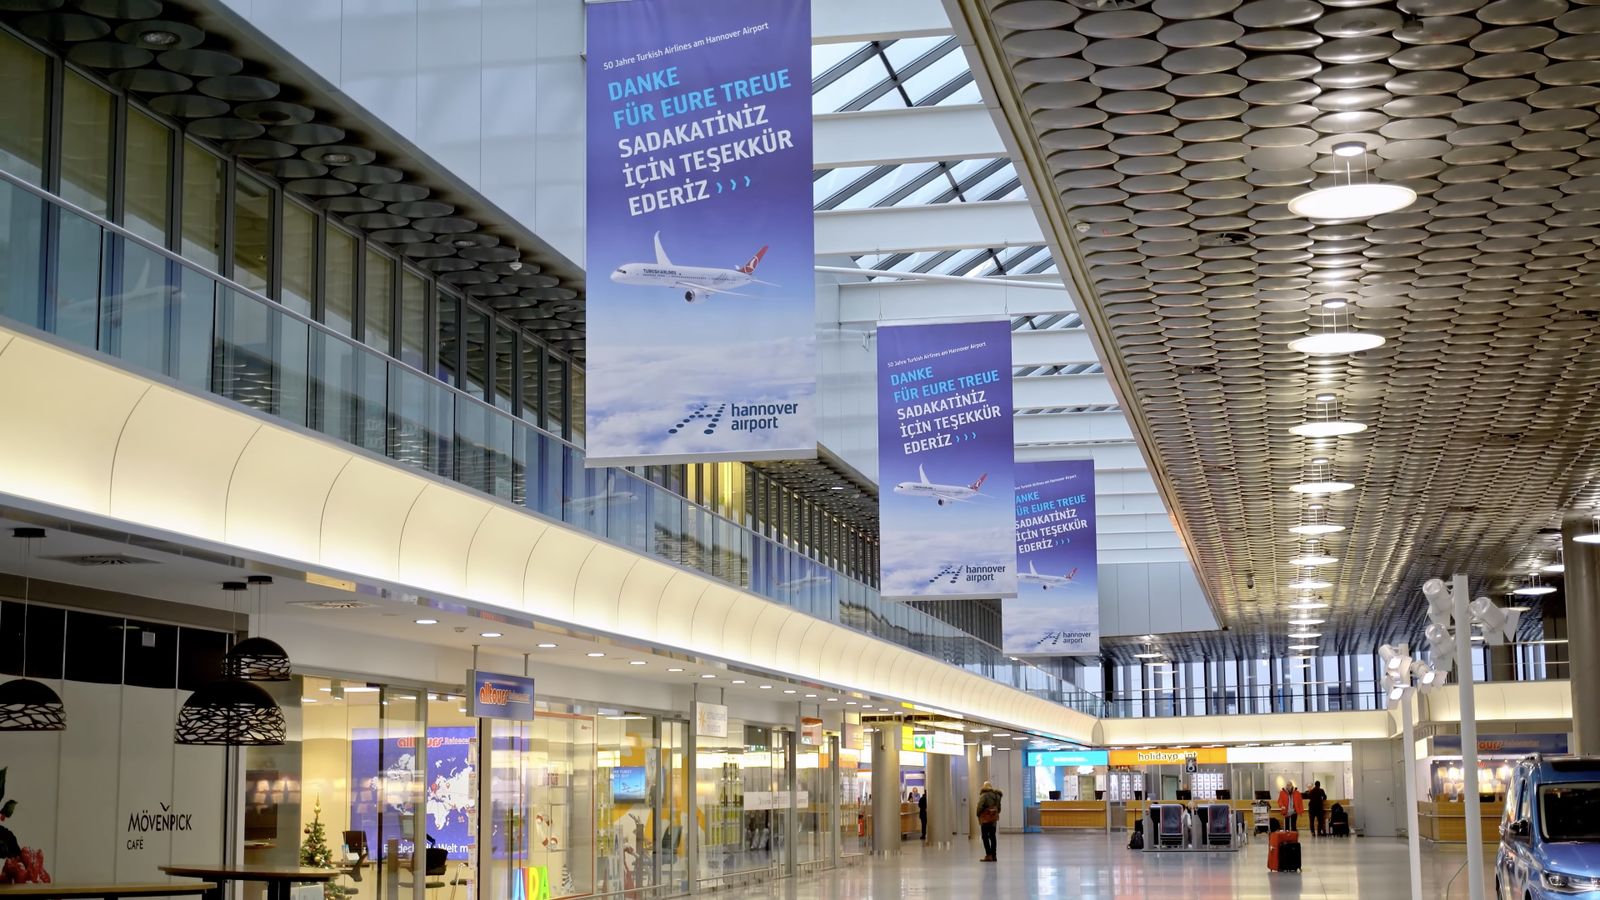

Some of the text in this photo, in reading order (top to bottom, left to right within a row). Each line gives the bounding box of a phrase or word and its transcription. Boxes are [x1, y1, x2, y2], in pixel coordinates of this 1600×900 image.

[603, 21, 769, 71] 50 Jahre Turkish Airlines am Hannover Airport
[608, 66, 680, 101] DANKE
[613, 68, 792, 130] FÜR EURE TREUE
[618, 103, 768, 158] SADAKATİNİZ
[622, 128, 794, 189] İÇİN TEŞEKKÜR
[628, 178, 710, 217] EDERİZ
[907, 354, 924, 364] Turkish
[923, 351, 941, 361] Airlines
[948, 345, 970, 354] Hannover
[970, 341, 986, 350] Airport
[890, 366, 934, 386] DANKE
[893, 369, 1000, 403] FÜR EURE TREUE
[731, 402, 798, 417] hannover
[897, 389, 987, 420] SADAKATİNİZ
[731, 415, 778, 432] airport
[900, 404, 1002, 439] İÇİN TEŞEKKÜR
[904, 432, 952, 455] EDERİZ
[1016, 491, 1039, 504] ANKE
[1016, 494, 1087, 516] ÜR EURE TREUE
[1015, 507, 1077, 529] SADAKATİNİZ
[1016, 518, 1088, 542] İÇİN TEŞEKKÜR
[1018, 537, 1053, 554] EDERİZ
[965, 564, 1006, 574] hannover
[965, 573, 995, 583] airport
[1138, 751, 1197, 762] holidaypint
[127, 810, 192, 833] MÖVENPICK
[126, 836, 144, 850] CAFÉ
